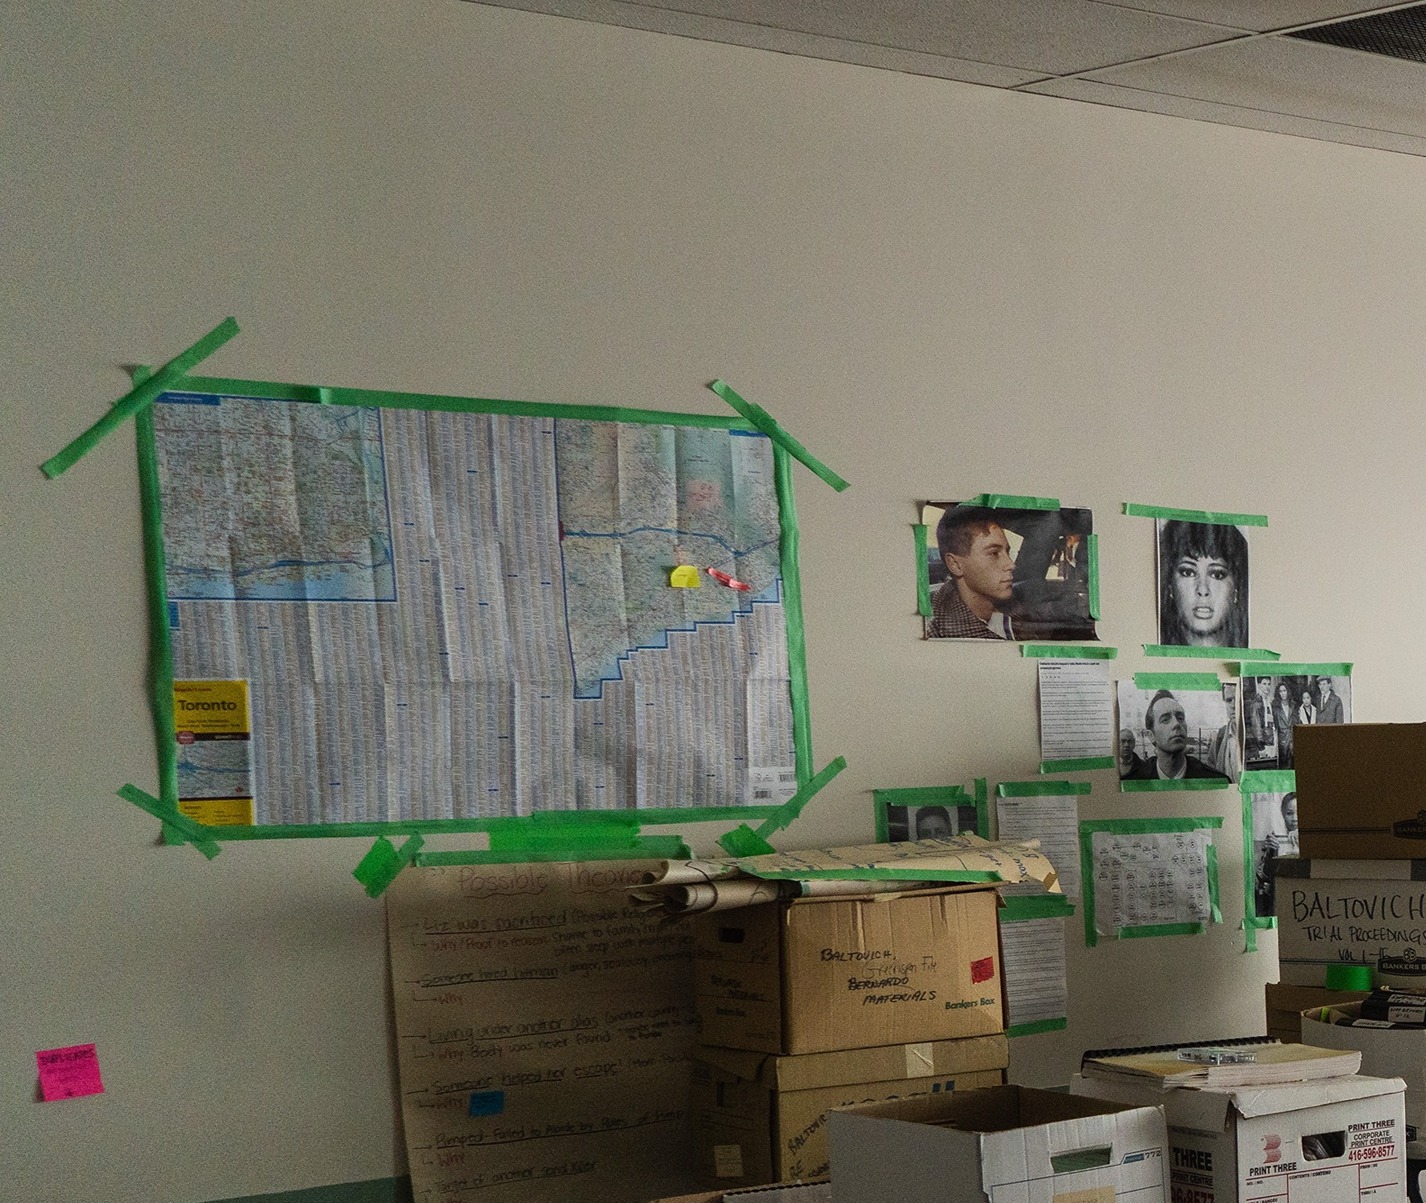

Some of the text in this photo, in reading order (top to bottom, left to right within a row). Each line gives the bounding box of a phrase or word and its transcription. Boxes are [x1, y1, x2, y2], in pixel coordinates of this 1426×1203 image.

[178, 699, 237, 712] Toronto
[458, 866, 548, 892] Possible
[1292, 889, 1425, 922] BALTOVICH
[1302, 924, 1343, 942] TRIAL
[1382, 962, 1420, 972] BANKERS
[848, 976, 909, 991] BERNARDO
[863, 990, 937, 1006] MATERIALS
[945, 998, 995, 1010] Bankers Box
[1348, 1119, 1395, 1132] PRINT THREE
[1354, 1130, 1390, 1140] CORPORATE
[1351, 1136, 1392, 1148] PRINT CENTRE
[1144, 1150, 1161, 1160] 772
[1172, 1147, 1213, 1172] THREE
[1249, 1162, 1297, 1176] PRINT THREE
[1188, 1176, 1214, 1187] CENTRE
